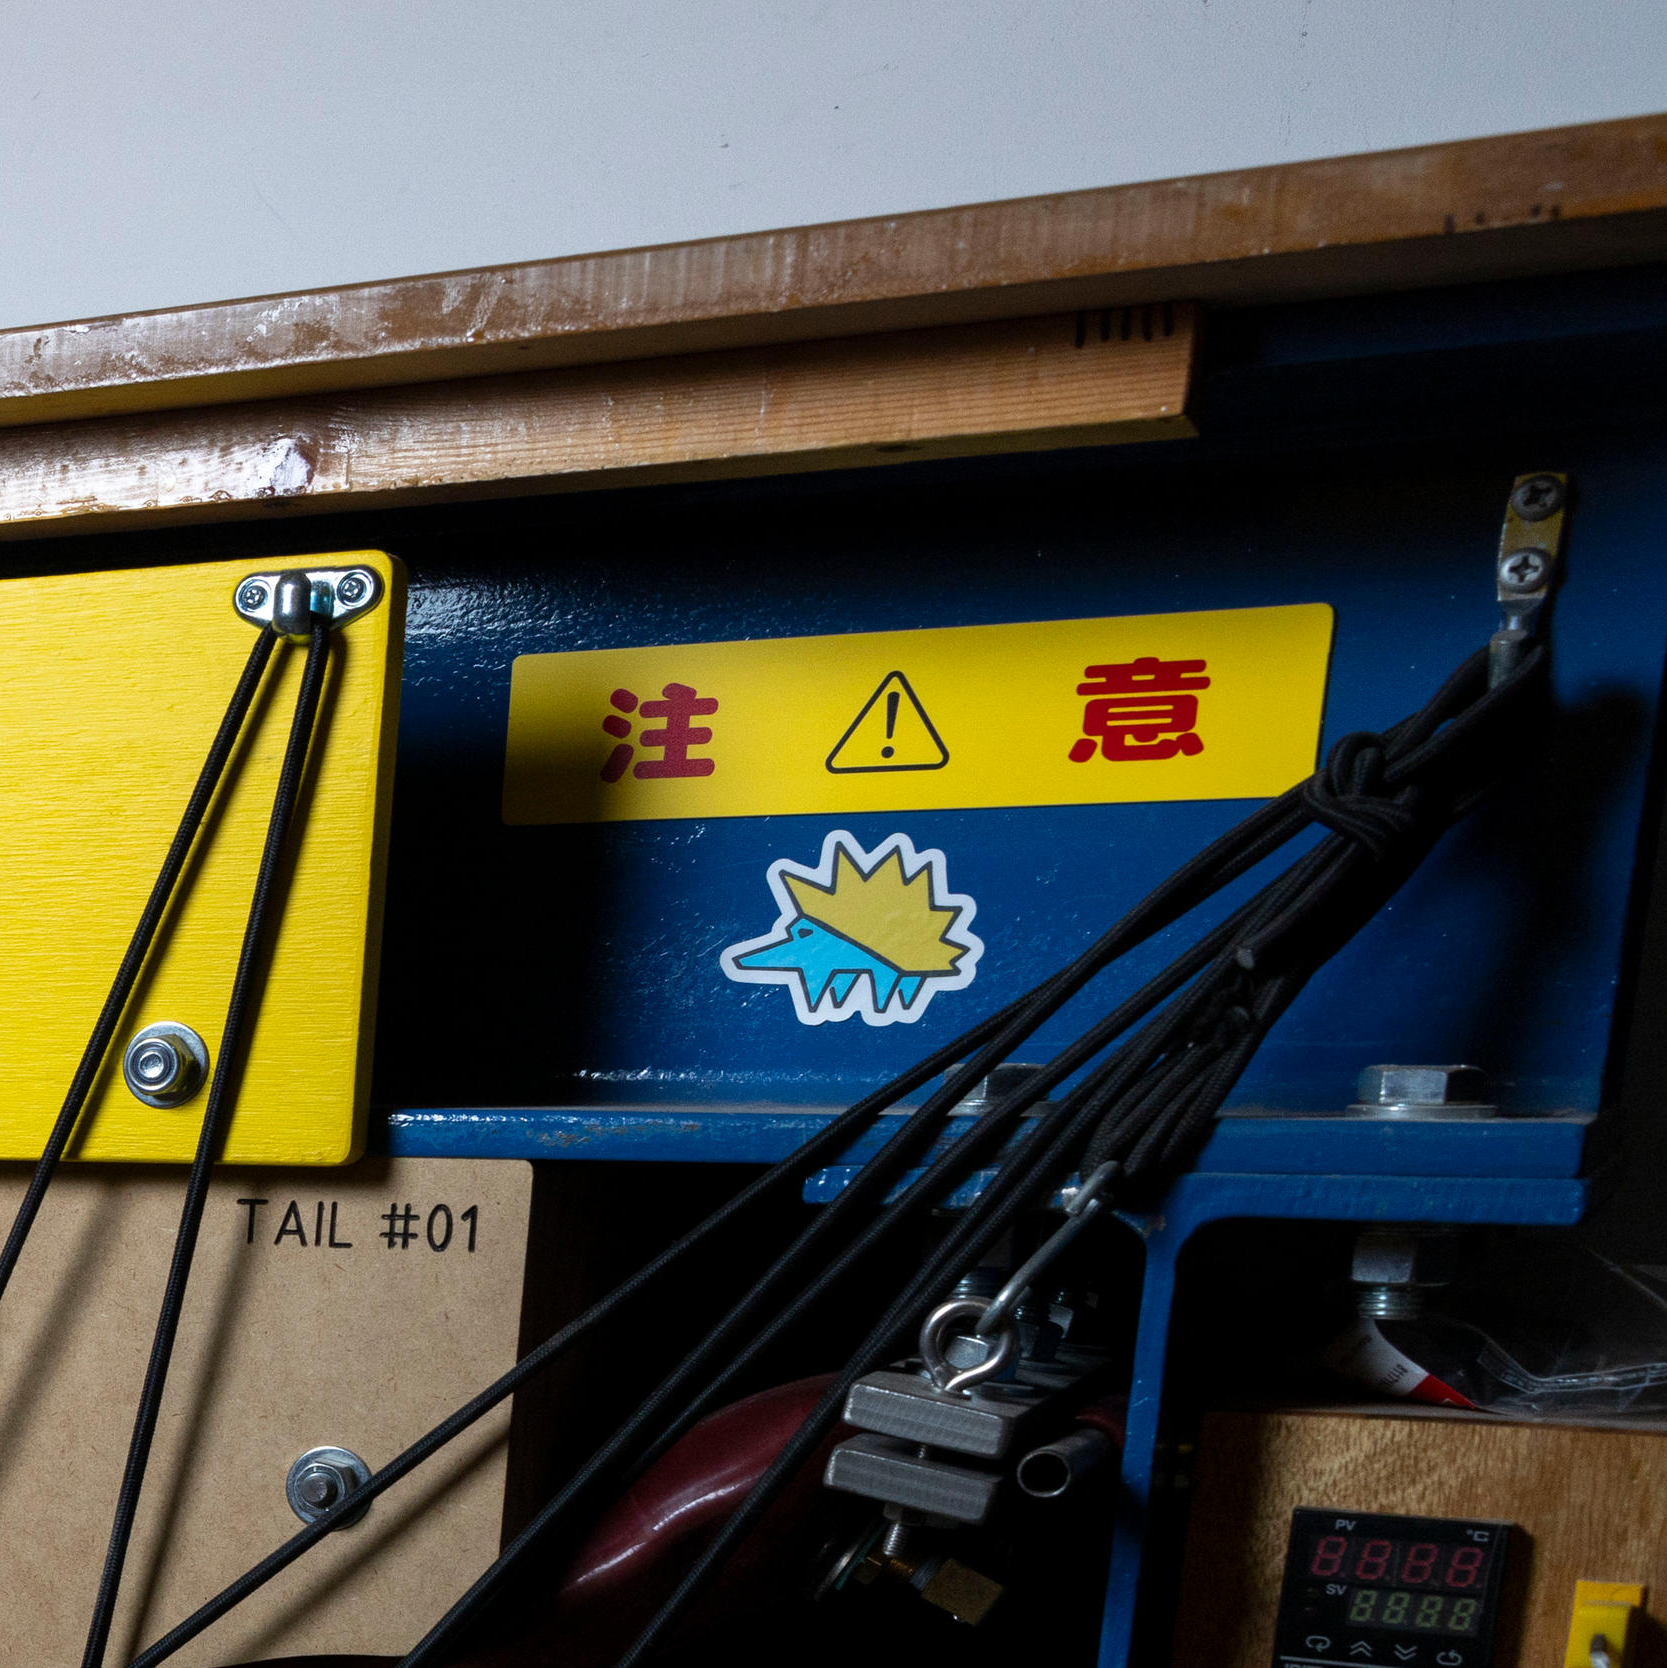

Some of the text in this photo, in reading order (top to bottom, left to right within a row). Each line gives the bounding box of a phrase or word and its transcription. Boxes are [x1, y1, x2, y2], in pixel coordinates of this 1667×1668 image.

[237, 1198, 479, 1252] TAIL #01
[1335, 1519, 1357, 1531] PV
[1325, 1583, 1347, 1596] SV
